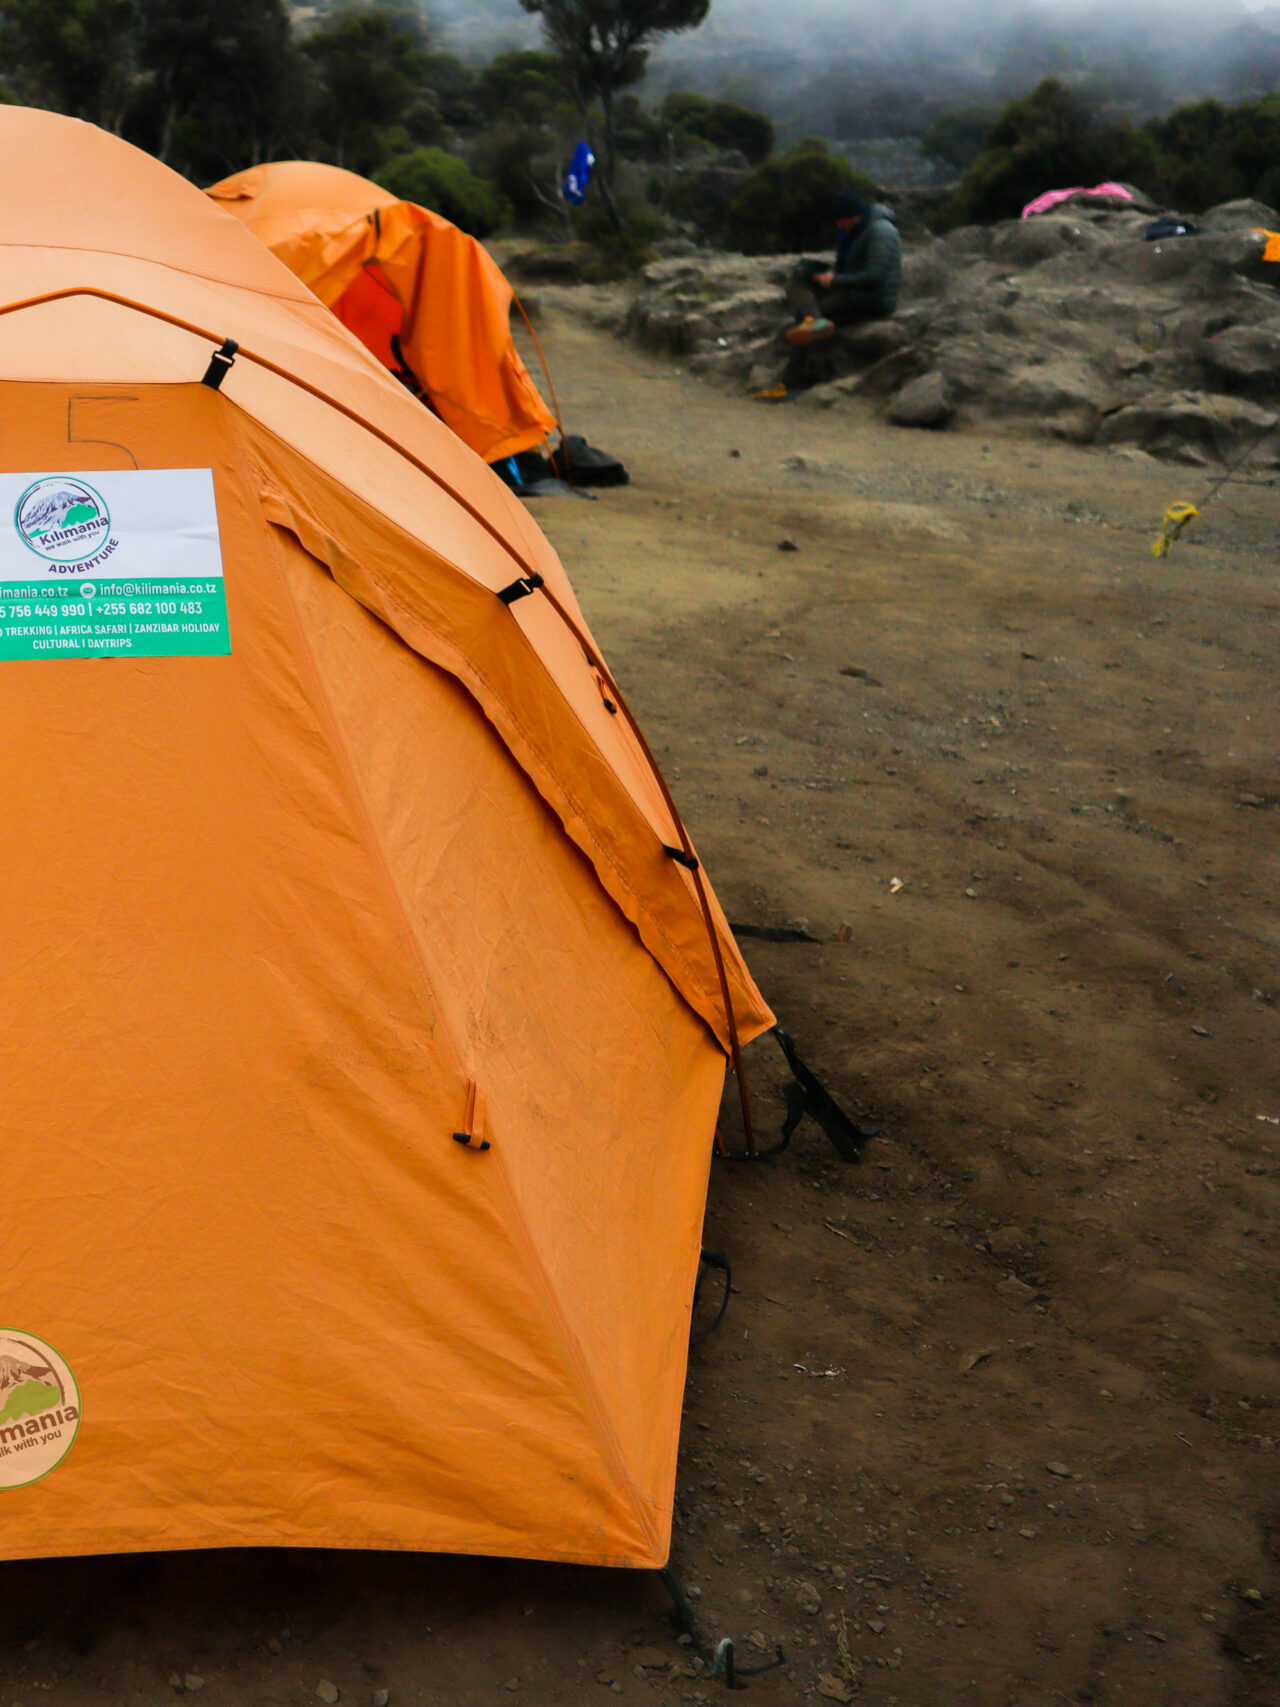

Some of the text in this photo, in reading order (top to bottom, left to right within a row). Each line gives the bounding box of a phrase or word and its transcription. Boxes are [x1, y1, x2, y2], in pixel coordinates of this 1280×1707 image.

[39, 516, 109, 545] Kilimania
[56, 537, 72, 547] walk
[73, 533, 87, 542] with
[48, 537, 119, 573] ADVENTURE
[100, 582, 217, 596] info@kilimania.co.tz
[8, 605, 32, 618] 756
[34, 605, 58, 617] 449
[61, 604, 85, 616] 990
[96, 603, 126, 615] +255
[129, 602, 152, 615] 682
[155, 602, 177, 614] 100
[180, 601, 203, 614] 483
[5, 626, 52, 637] TREKKING
[60, 624, 93, 635] AFRICA
[94, 624, 127, 634] SAFARI
[134, 623, 180, 633] ZANZIBAR
[181, 623, 220, 632] HOLIDAY
[32, 639, 80, 649] CULTURAL
[88, 638, 133, 648] DAYTRIPS
[13, 1437, 38, 1452] with
[40, 1429, 62, 1444] you
